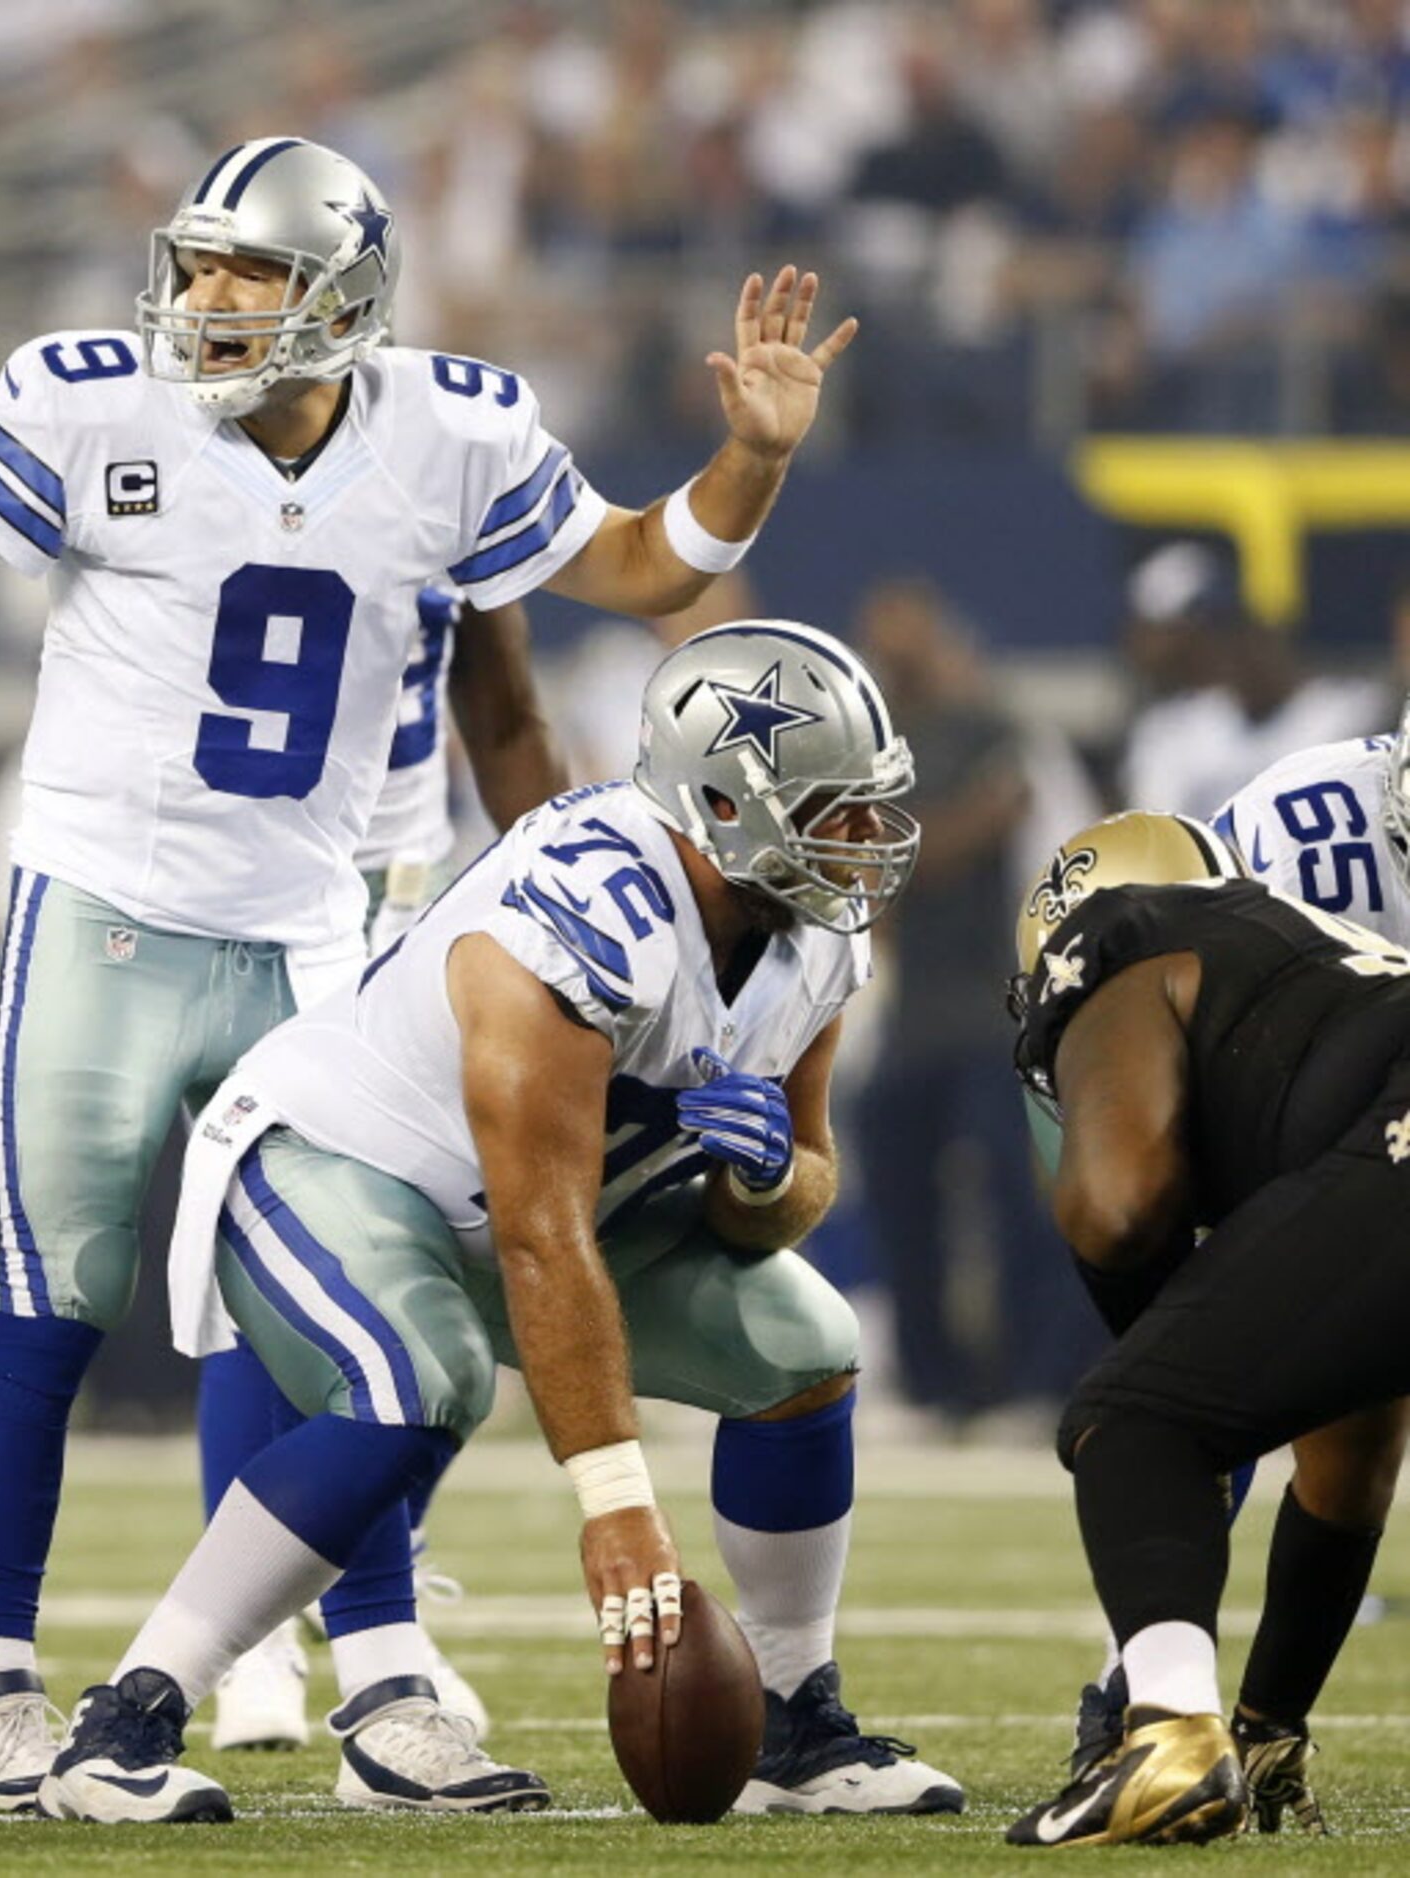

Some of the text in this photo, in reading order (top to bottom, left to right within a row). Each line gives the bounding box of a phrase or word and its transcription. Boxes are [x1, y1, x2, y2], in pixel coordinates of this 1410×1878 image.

[39, 338, 139, 384] 9
[431, 355, 519, 408] 9
[109, 464, 155, 502] C
[192, 562, 356, 801] 9
[540, 817, 675, 942] 72
[1273, 780, 1384, 915] 65
